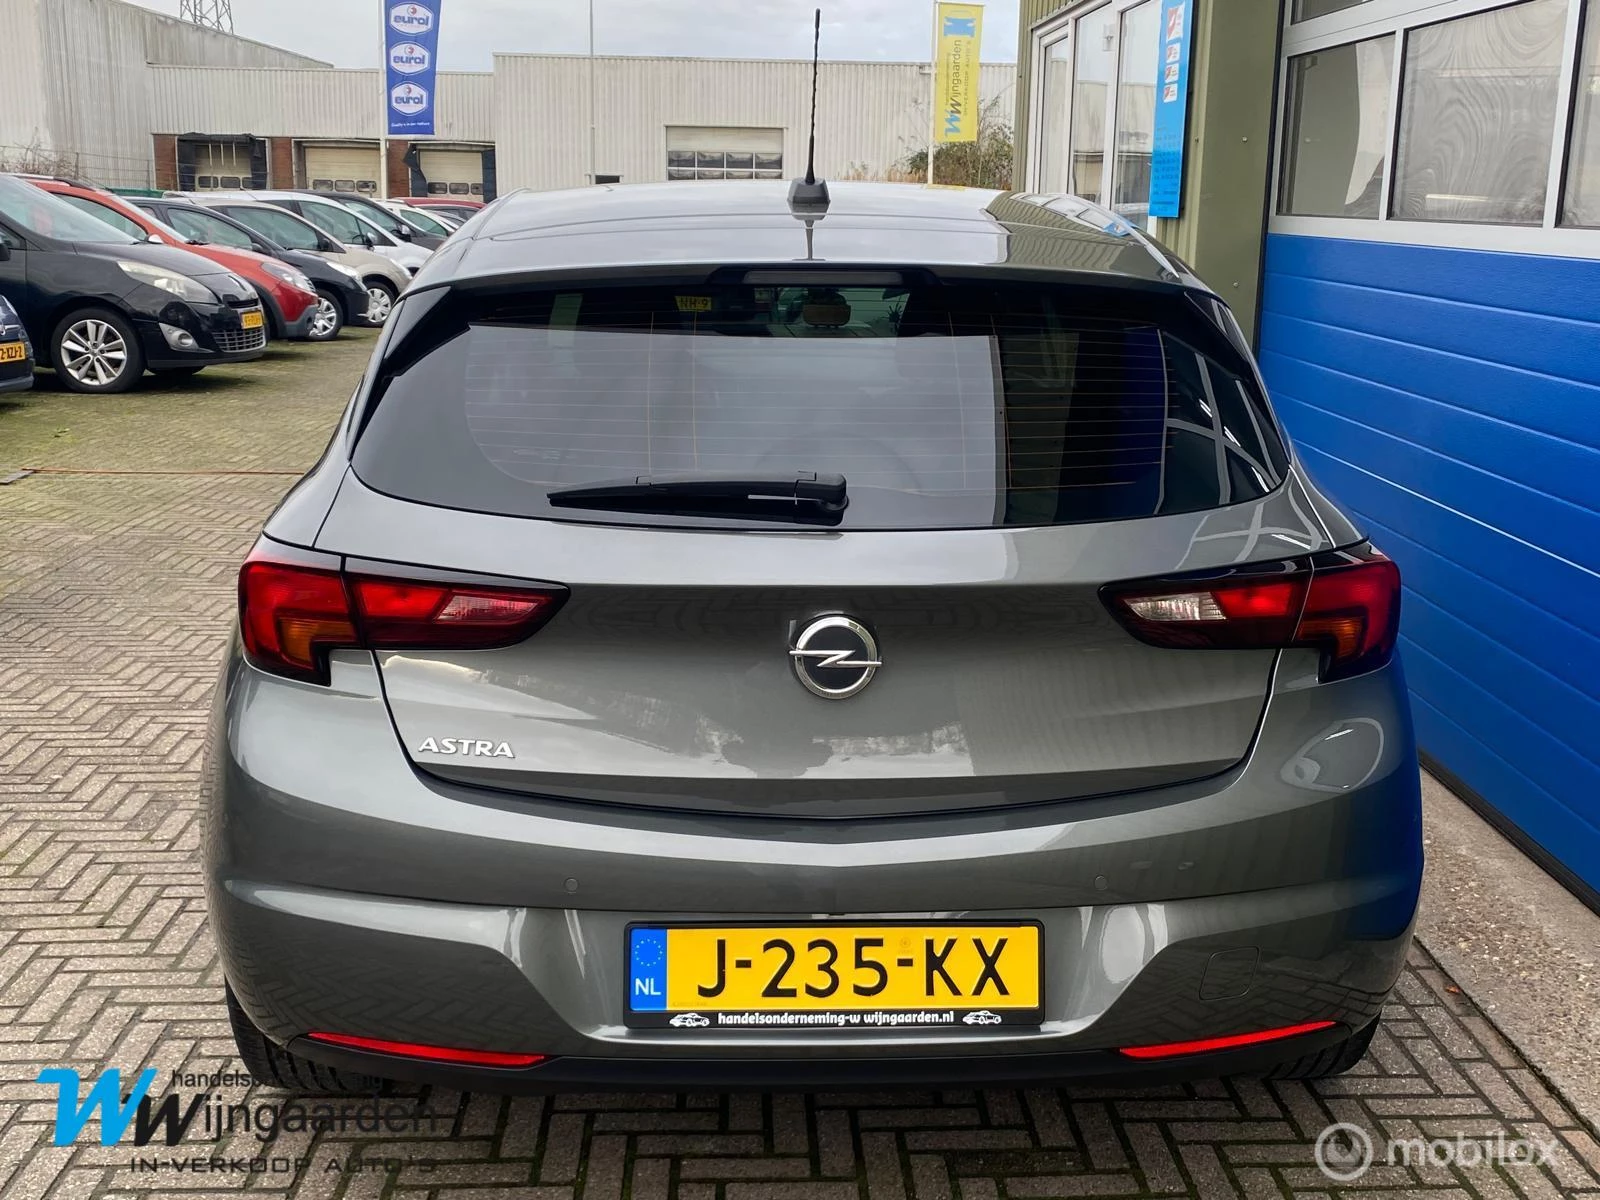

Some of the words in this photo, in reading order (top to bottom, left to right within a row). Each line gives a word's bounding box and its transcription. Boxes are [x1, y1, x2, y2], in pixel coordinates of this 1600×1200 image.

[393, 15, 429, 26] eurol
[393, 54, 425, 65] eurol
[394, 93, 424, 105] eurol
[418, 737, 515, 758] ASTRA
[697, 937, 1010, 998] J-235-KX
[635, 978, 661, 996] NL
